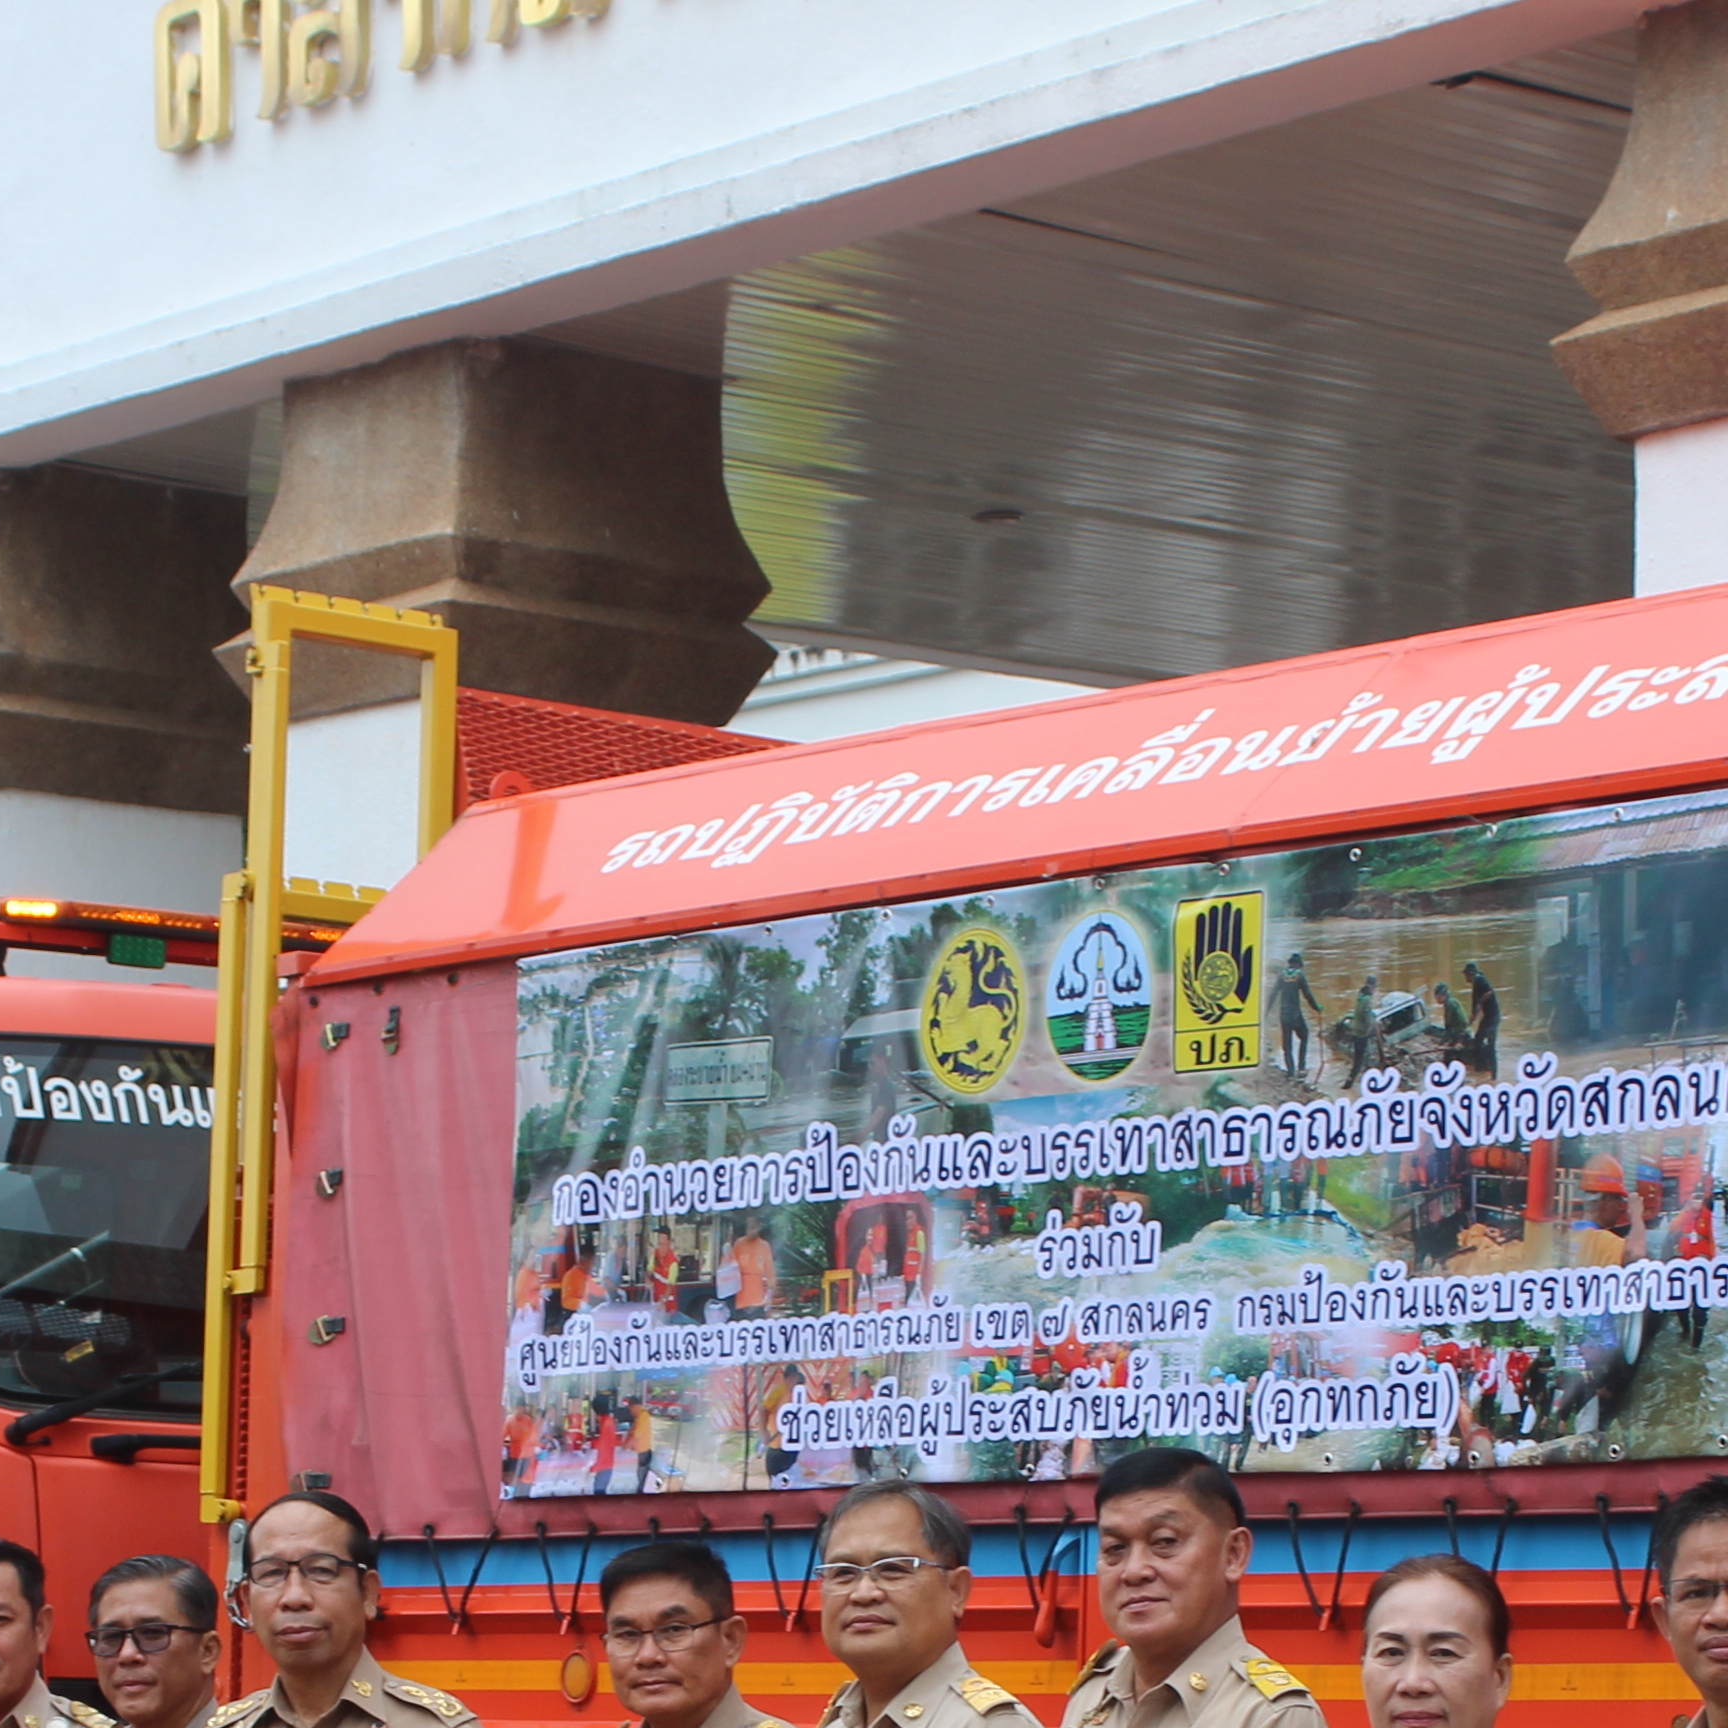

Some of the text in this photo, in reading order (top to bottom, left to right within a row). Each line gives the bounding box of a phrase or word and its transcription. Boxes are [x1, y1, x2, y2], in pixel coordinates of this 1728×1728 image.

[1189, 1033, 1251, 1066] ปภ.
[1038, 1204, 1157, 1275] ร่วมกับ
[519, 1299, 961, 1387] ศูนย์ป้องกันและบรรเทาสาธารณภัย
[975, 1306, 1030, 1341] เขต
[1080, 1297, 1212, 1338] สกลนคร
[782, 1358, 1244, 1457] ช่วยเหลือผู้ประสบภัยน้ำท่วม
